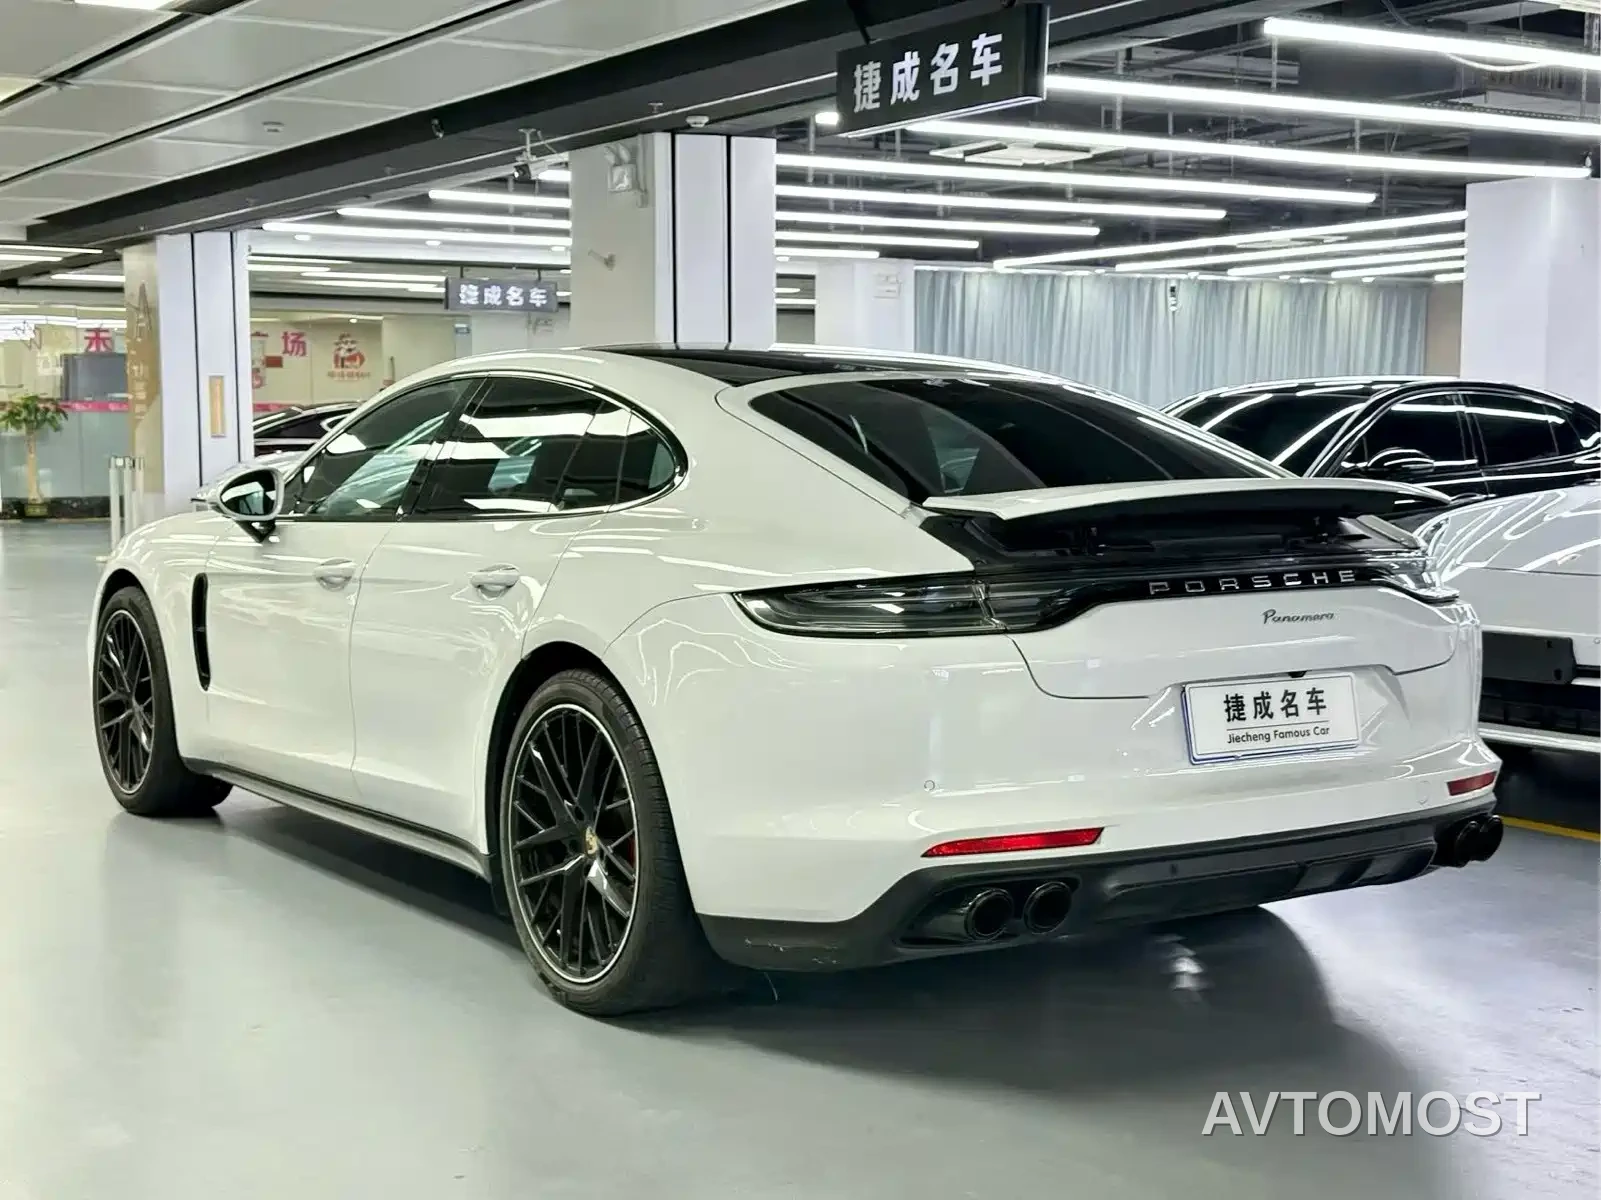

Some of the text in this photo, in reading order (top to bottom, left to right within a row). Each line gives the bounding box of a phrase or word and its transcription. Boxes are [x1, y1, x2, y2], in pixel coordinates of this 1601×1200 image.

[853, 32, 1003, 114] 捷成名车
[1149, 570, 1356, 595] PORSCHE
[1262, 609, 1334, 624] Panamera
[1223, 687, 1327, 722] 捷成名车
[1227, 726, 1330, 743] Jiecheng Famous Car
